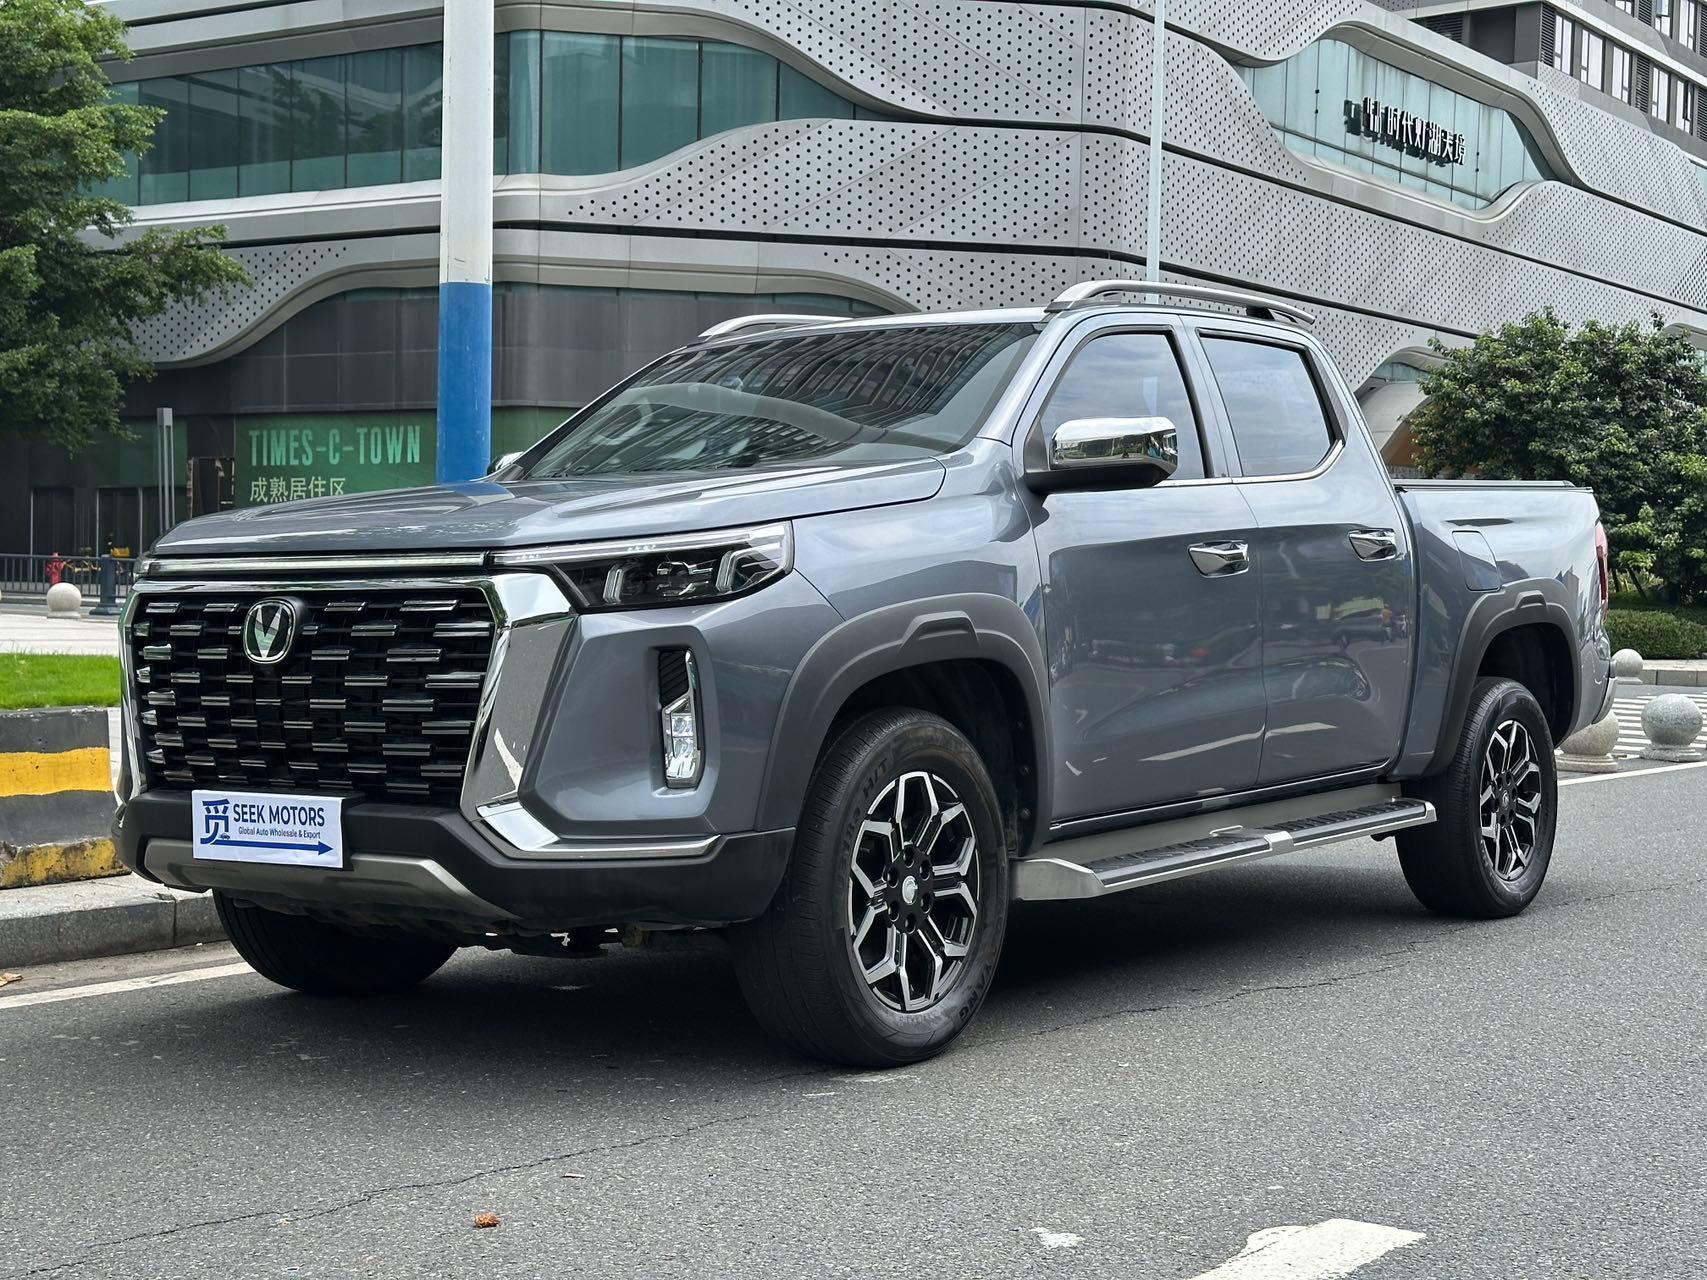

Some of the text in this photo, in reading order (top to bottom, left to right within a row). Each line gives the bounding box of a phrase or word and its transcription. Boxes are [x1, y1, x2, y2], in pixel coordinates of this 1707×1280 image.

[249, 425, 421, 467] TIMES-C-TOWN
[250, 476, 346, 503] 成熟居住区
[233, 803, 325, 827] SEEK MOTORS
[238, 826, 256, 836] Global
[256, 828, 269, 836] Auto
[269, 829, 298, 838] Wholesale
[303, 831, 321, 840] Export
